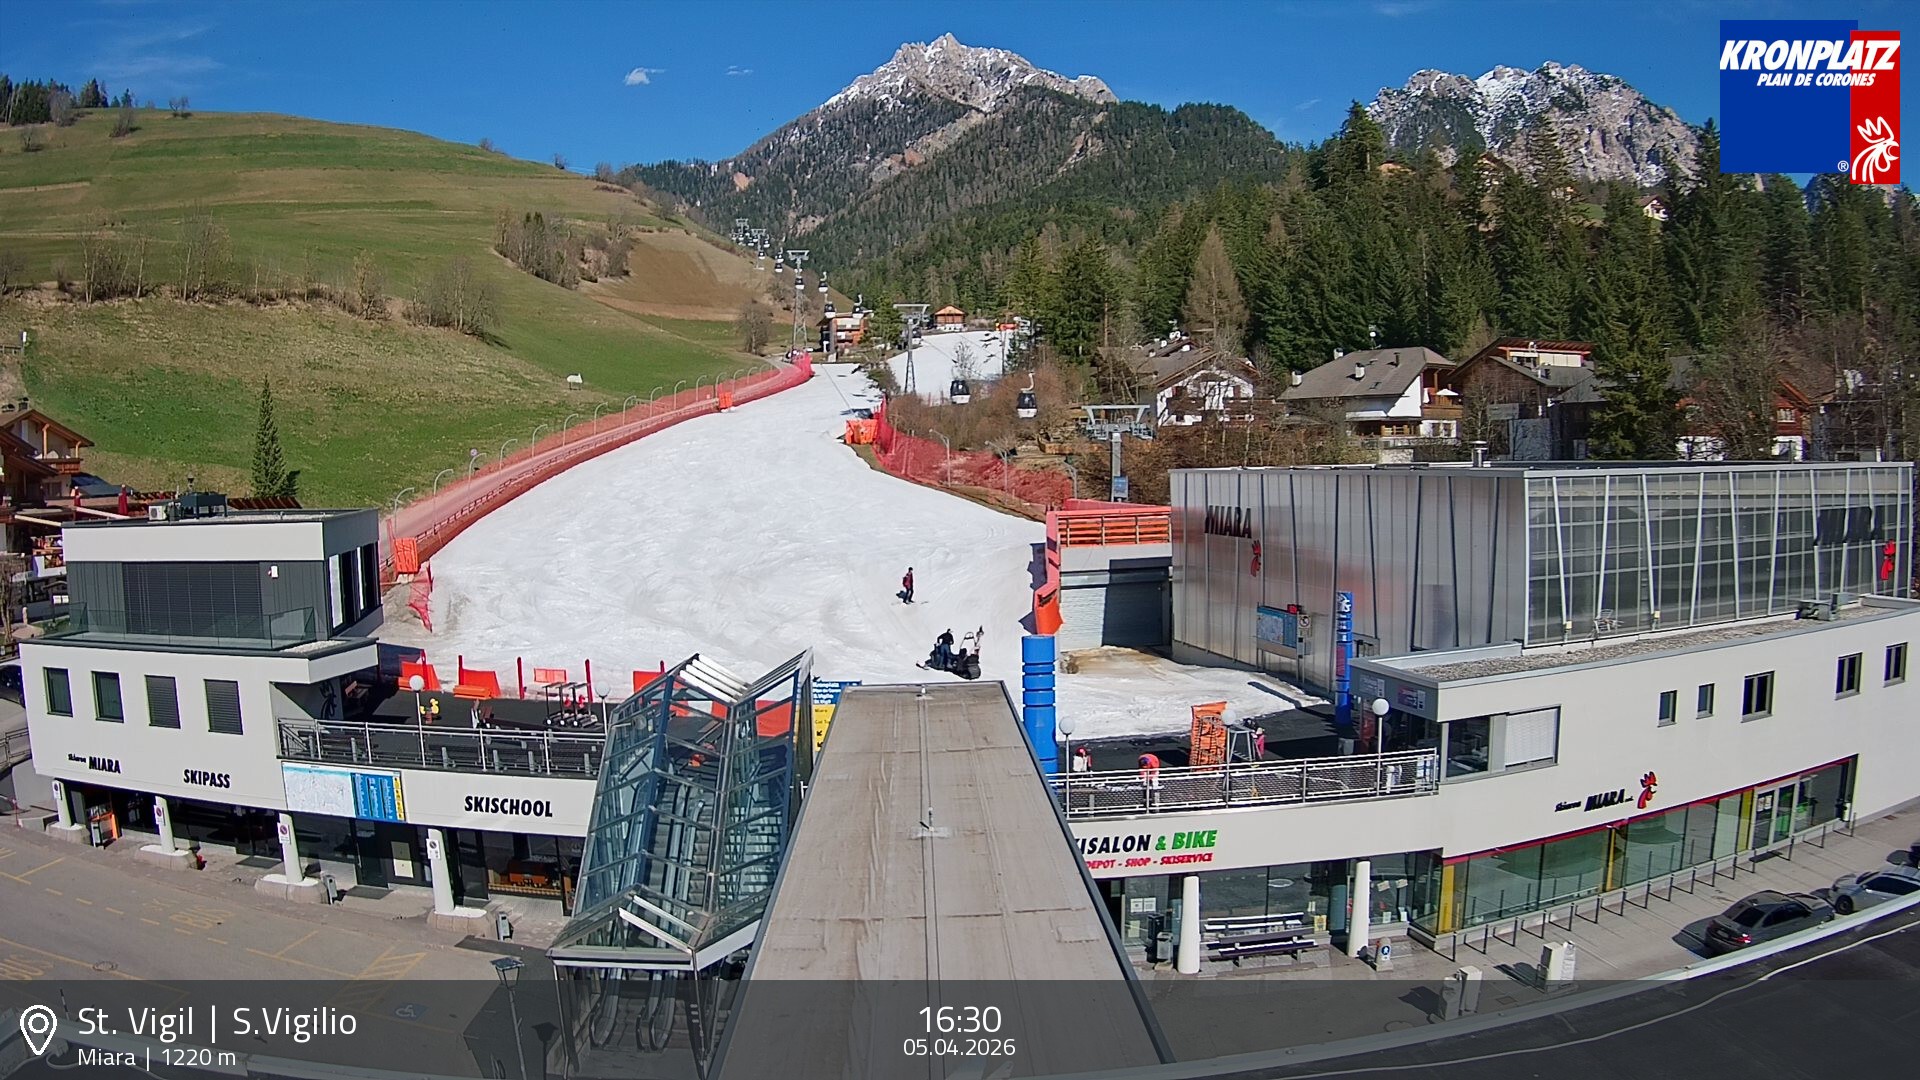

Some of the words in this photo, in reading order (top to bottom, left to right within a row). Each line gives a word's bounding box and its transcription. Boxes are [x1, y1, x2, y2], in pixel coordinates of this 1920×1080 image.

[1204, 505, 1252, 538] MIARA
[88, 756, 122, 774] MIARA
[183, 769, 231, 789] SKIPASS
[464, 795, 553, 818] SKISCHOOL
[1584, 789, 1626, 812] MIARA
[1154, 836, 1167, 851] &
[1171, 830, 1218, 850] BIKE
[1125, 857, 1151, 868] SHOP
[1160, 852, 1213, 866] SKISERVICE
